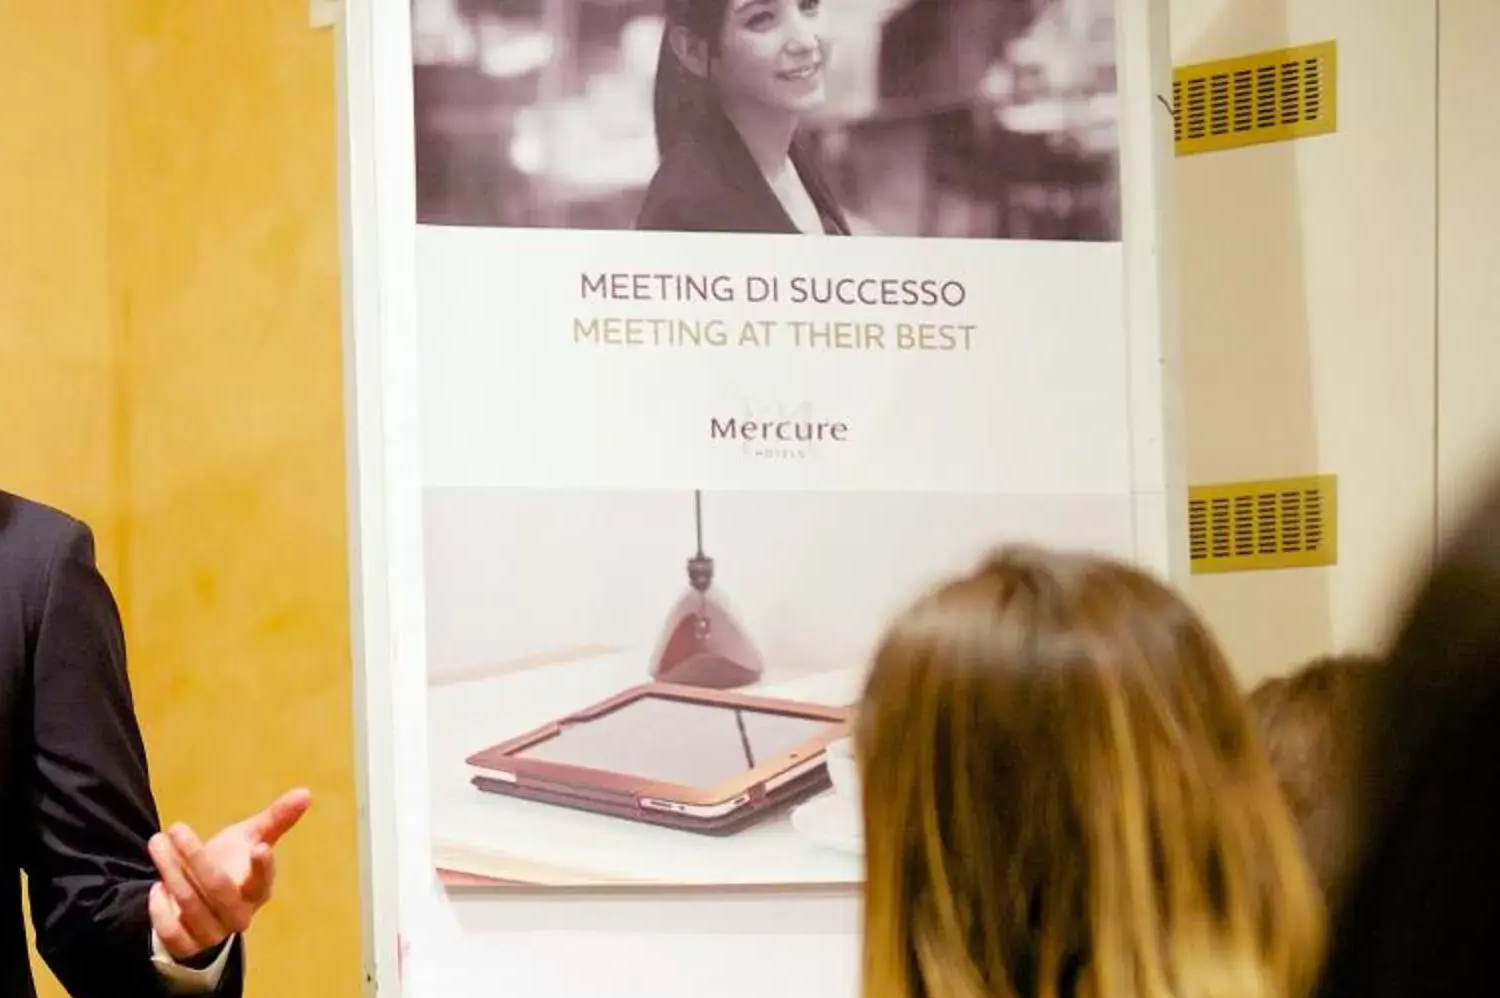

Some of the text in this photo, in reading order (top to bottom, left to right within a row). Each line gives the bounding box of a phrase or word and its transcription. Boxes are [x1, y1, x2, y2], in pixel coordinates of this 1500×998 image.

[580, 273, 966, 307] MEETING DI SUCCESSO
[572, 317, 977, 351] MEETING AT THEIR BEST
[710, 417, 848, 441] Mercure
